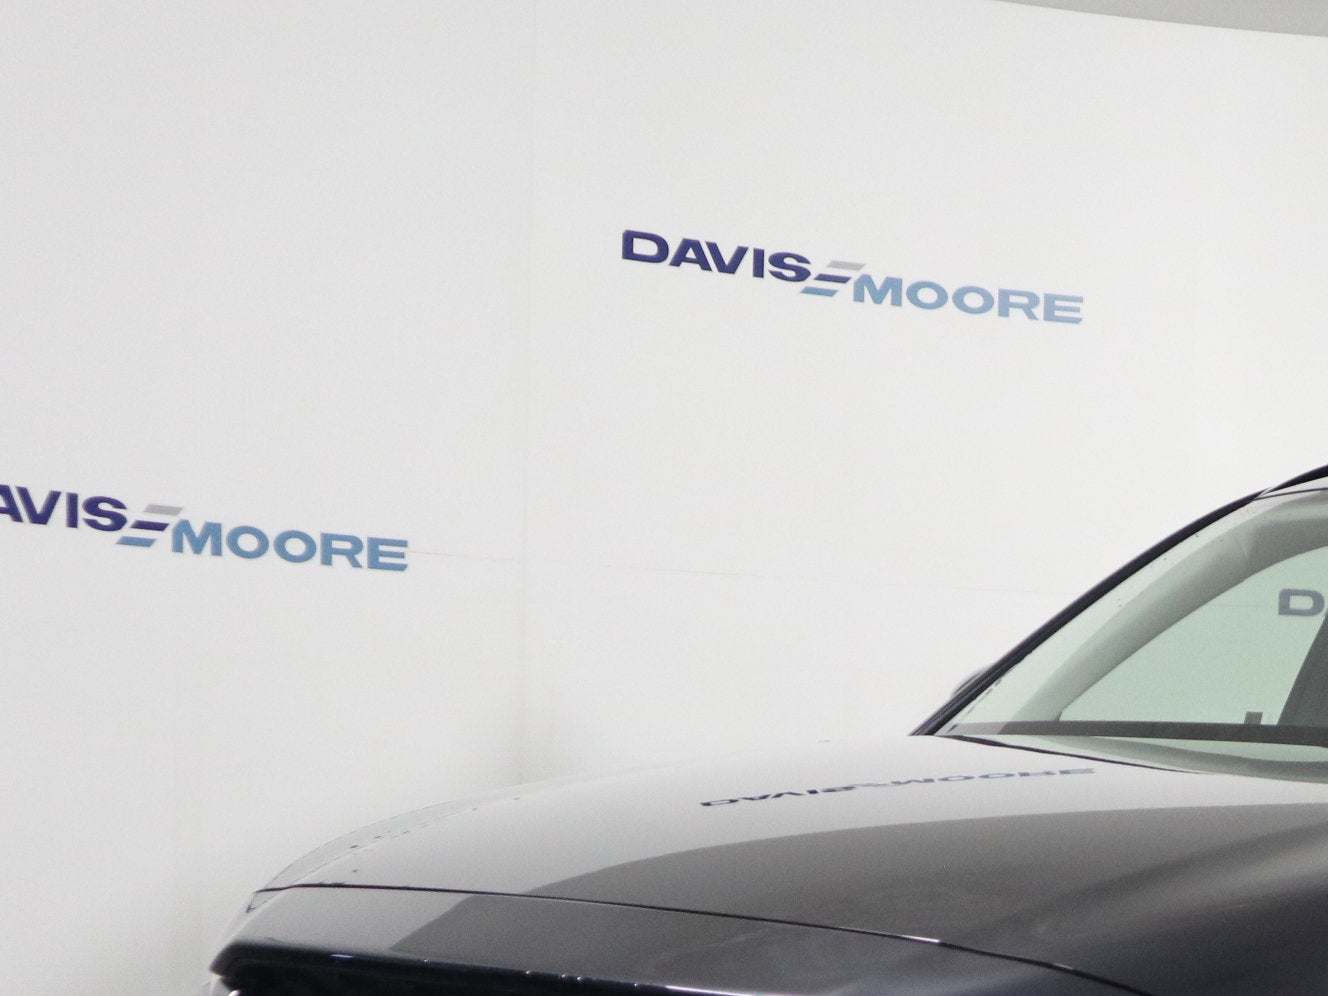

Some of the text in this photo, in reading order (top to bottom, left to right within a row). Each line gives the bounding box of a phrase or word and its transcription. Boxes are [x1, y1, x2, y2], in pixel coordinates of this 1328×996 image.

[621, 229, 1084, 325] DAVIS MOORE
[171, 518, 409, 573] MOORE
